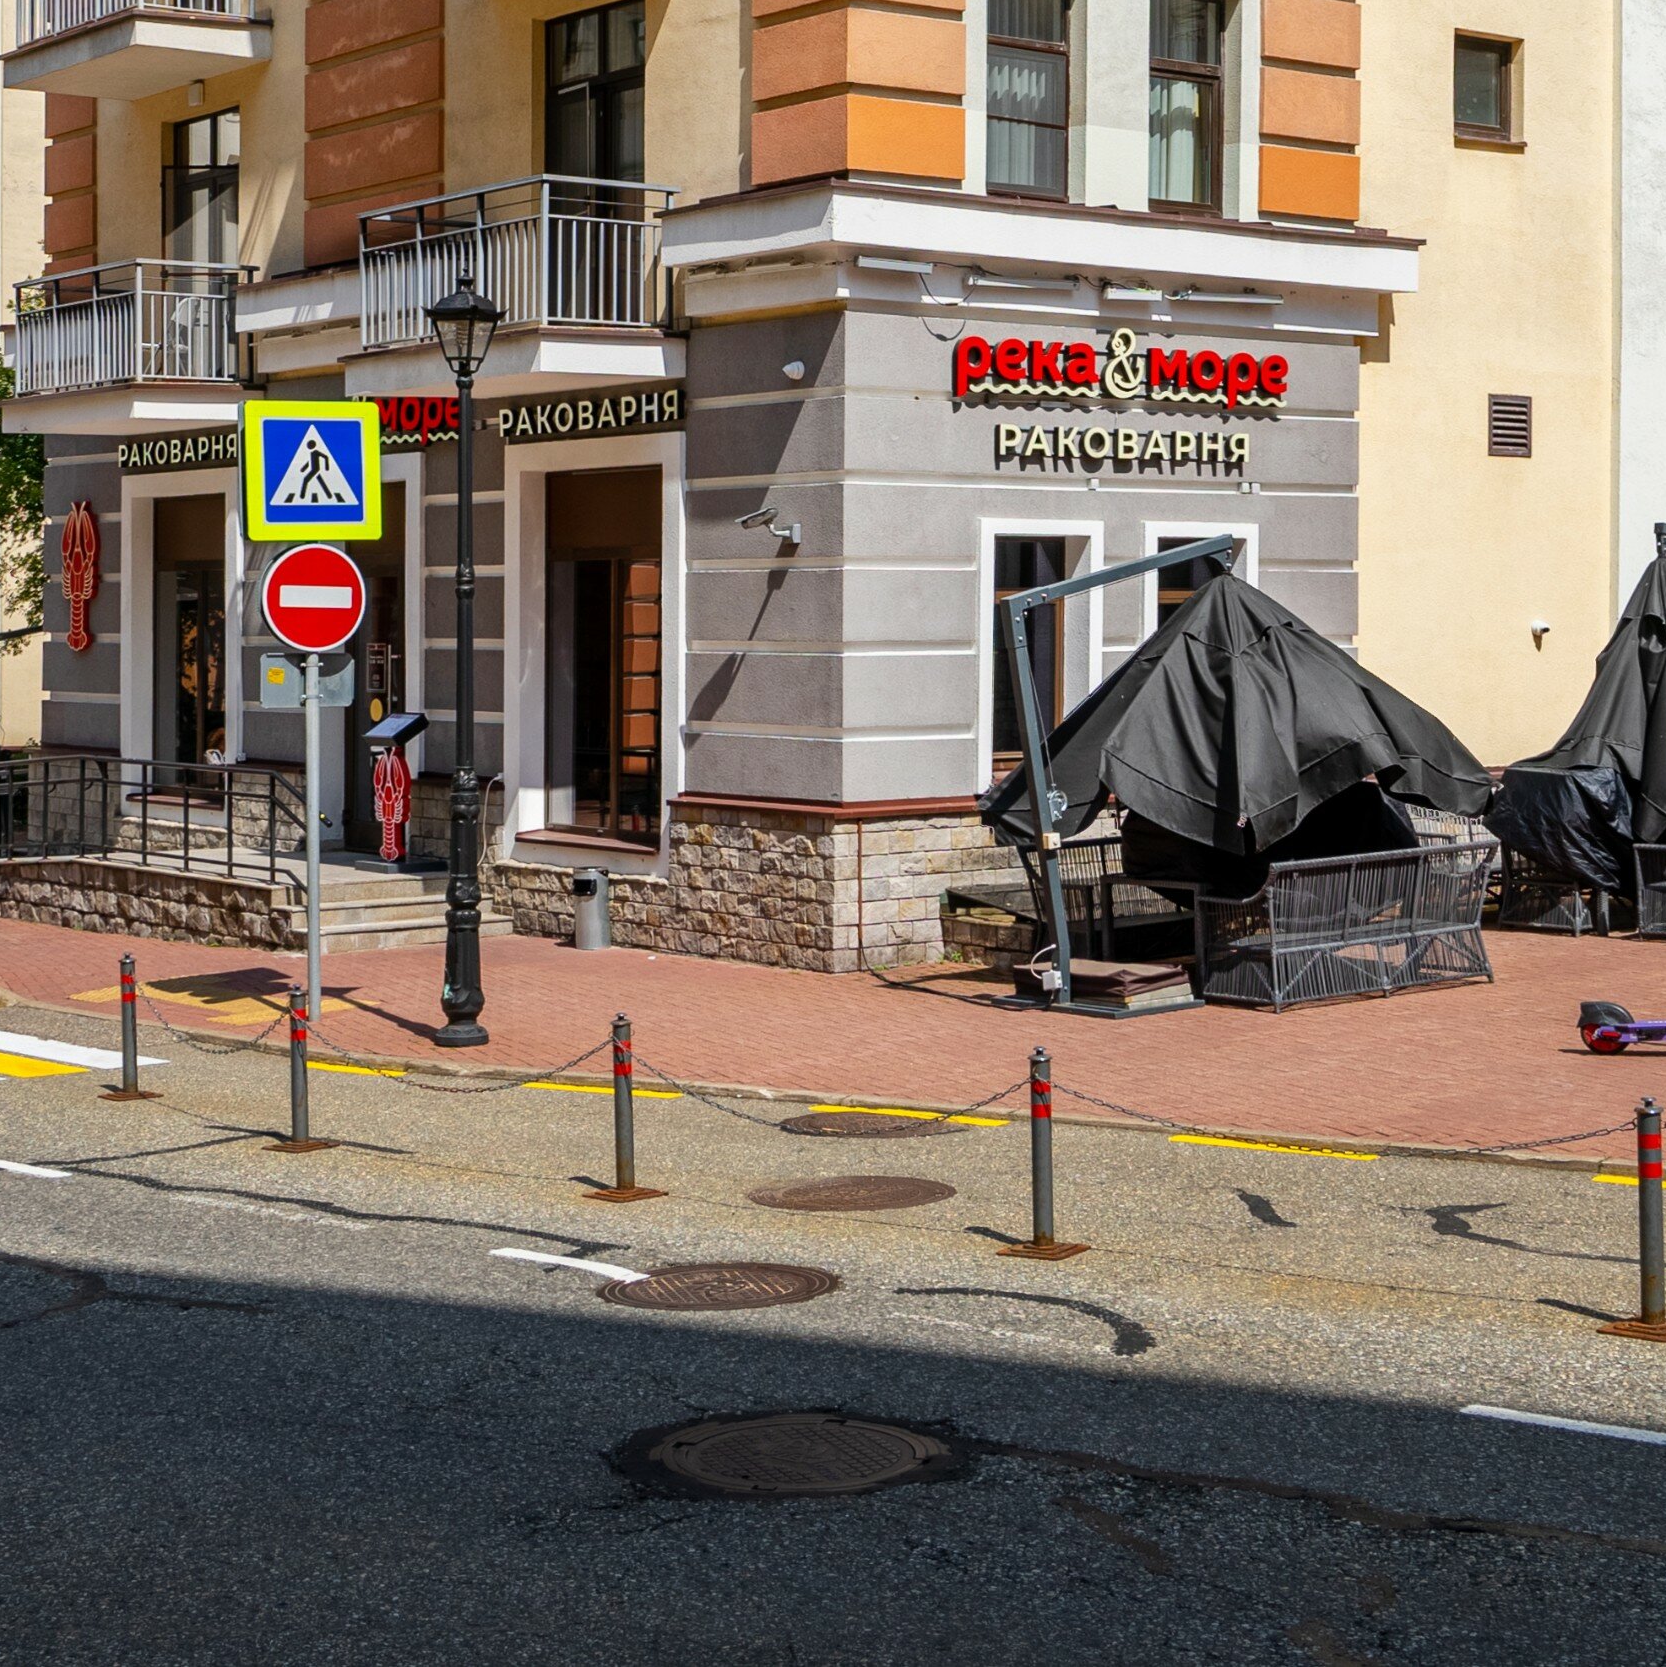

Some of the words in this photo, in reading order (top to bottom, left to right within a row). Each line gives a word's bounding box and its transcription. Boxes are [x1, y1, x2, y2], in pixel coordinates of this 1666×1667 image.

[955, 335, 1099, 398] река
[1150, 347, 1289, 411] море
[498, 389, 679, 438] РАКОВАРНЯ
[117, 432, 238, 468] РАКОВАРНЯ
[998, 422, 1250, 464] РАКОВАРНЯ
